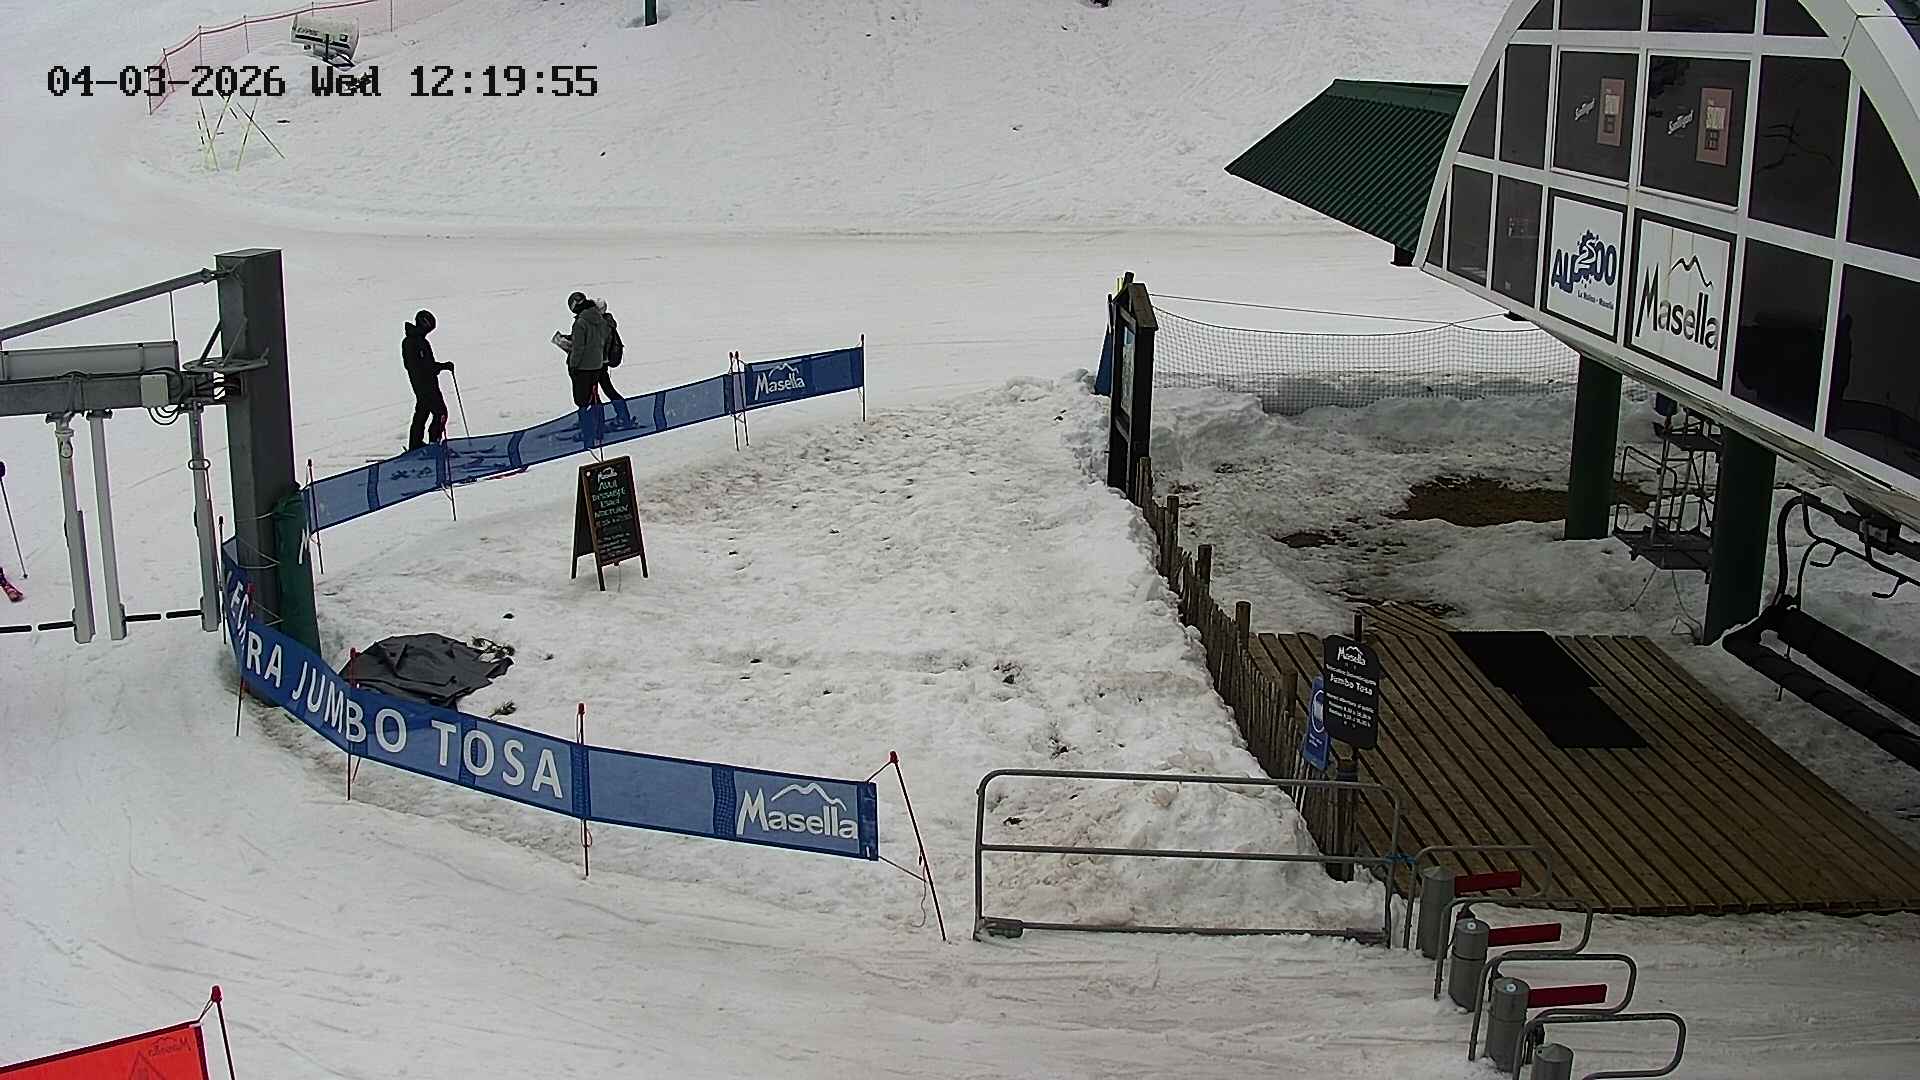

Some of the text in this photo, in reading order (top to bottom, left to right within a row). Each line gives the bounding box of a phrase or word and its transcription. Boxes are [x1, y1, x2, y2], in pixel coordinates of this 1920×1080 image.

[1635, 262, 1719, 350] Masella
[754, 372, 806, 400] Masella
[291, 660, 407, 753] JUMBO
[431, 719, 563, 799] TOSA
[736, 787, 858, 840] Masella
